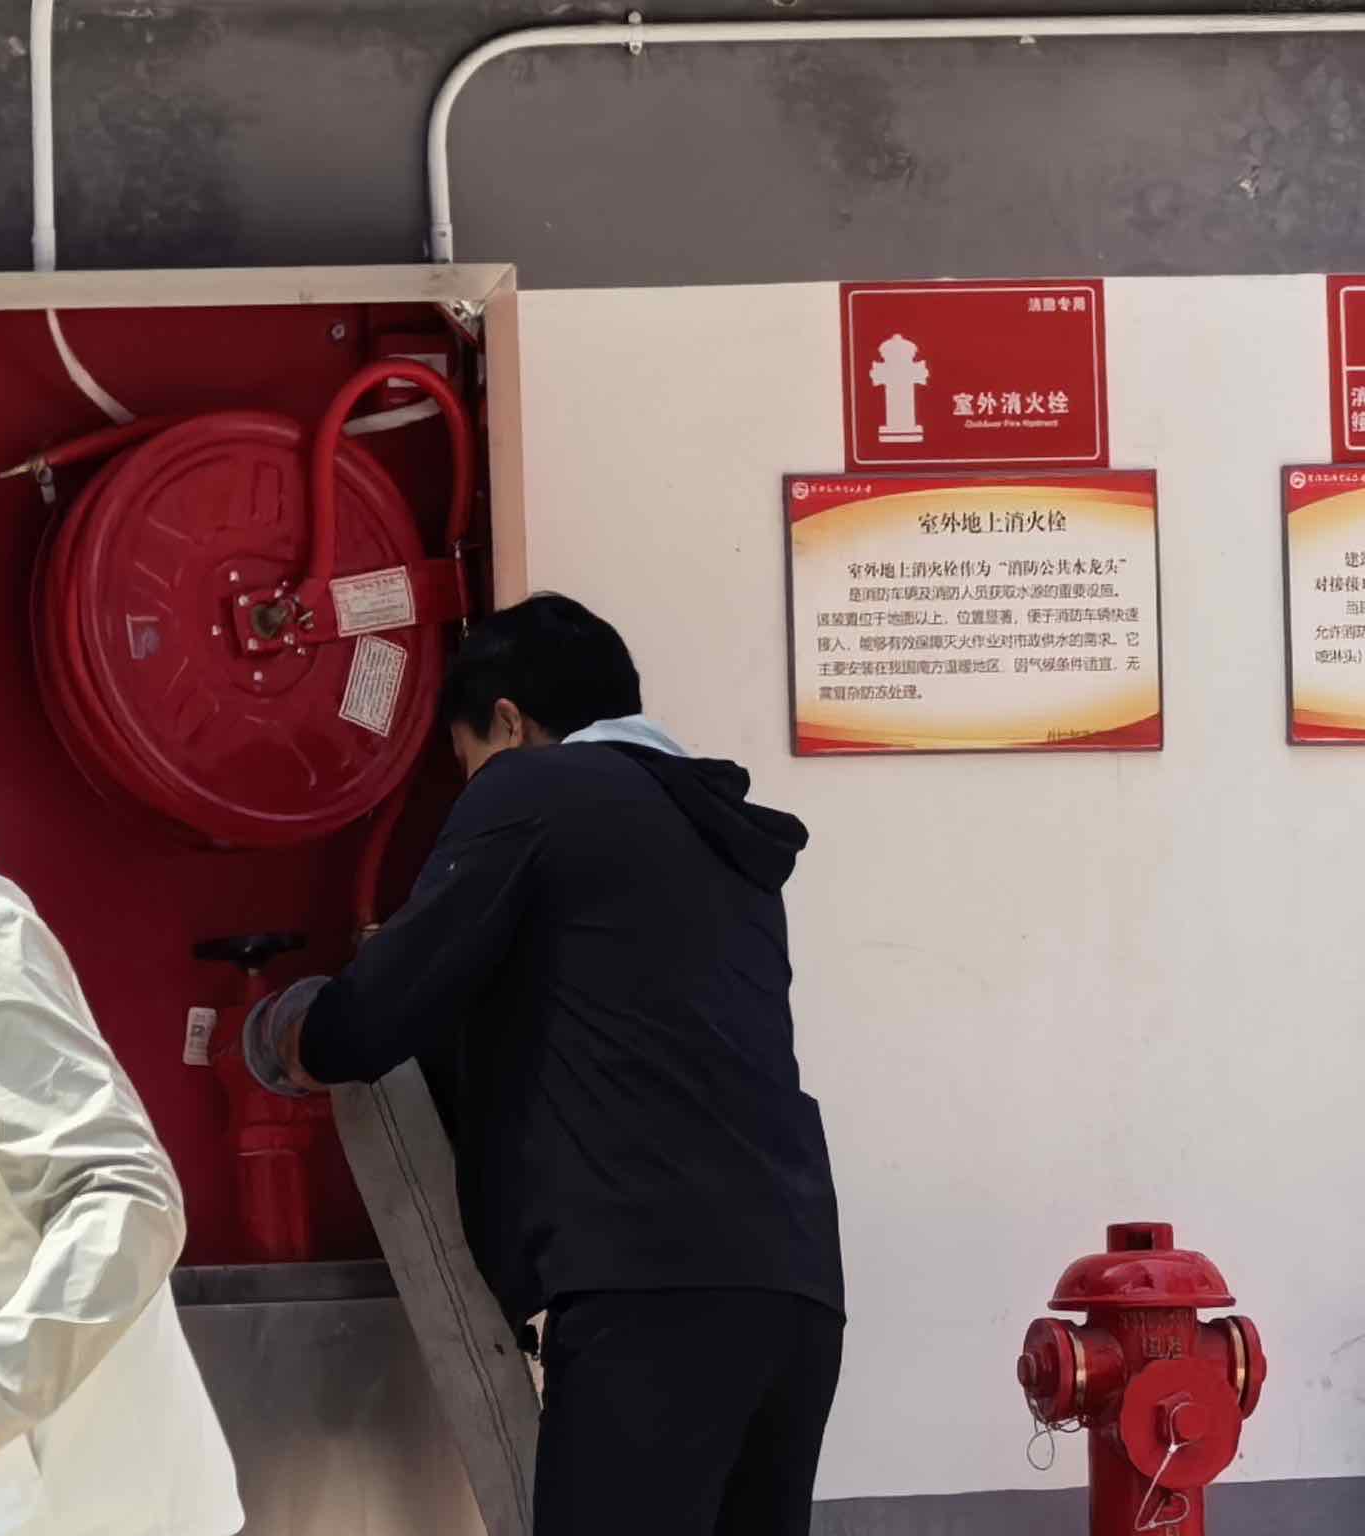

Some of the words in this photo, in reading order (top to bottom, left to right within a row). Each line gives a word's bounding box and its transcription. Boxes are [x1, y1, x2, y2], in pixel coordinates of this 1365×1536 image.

[952, 390, 1069, 416] 室外消火栓
[918, 509, 1068, 534] 室外地上消火栓
